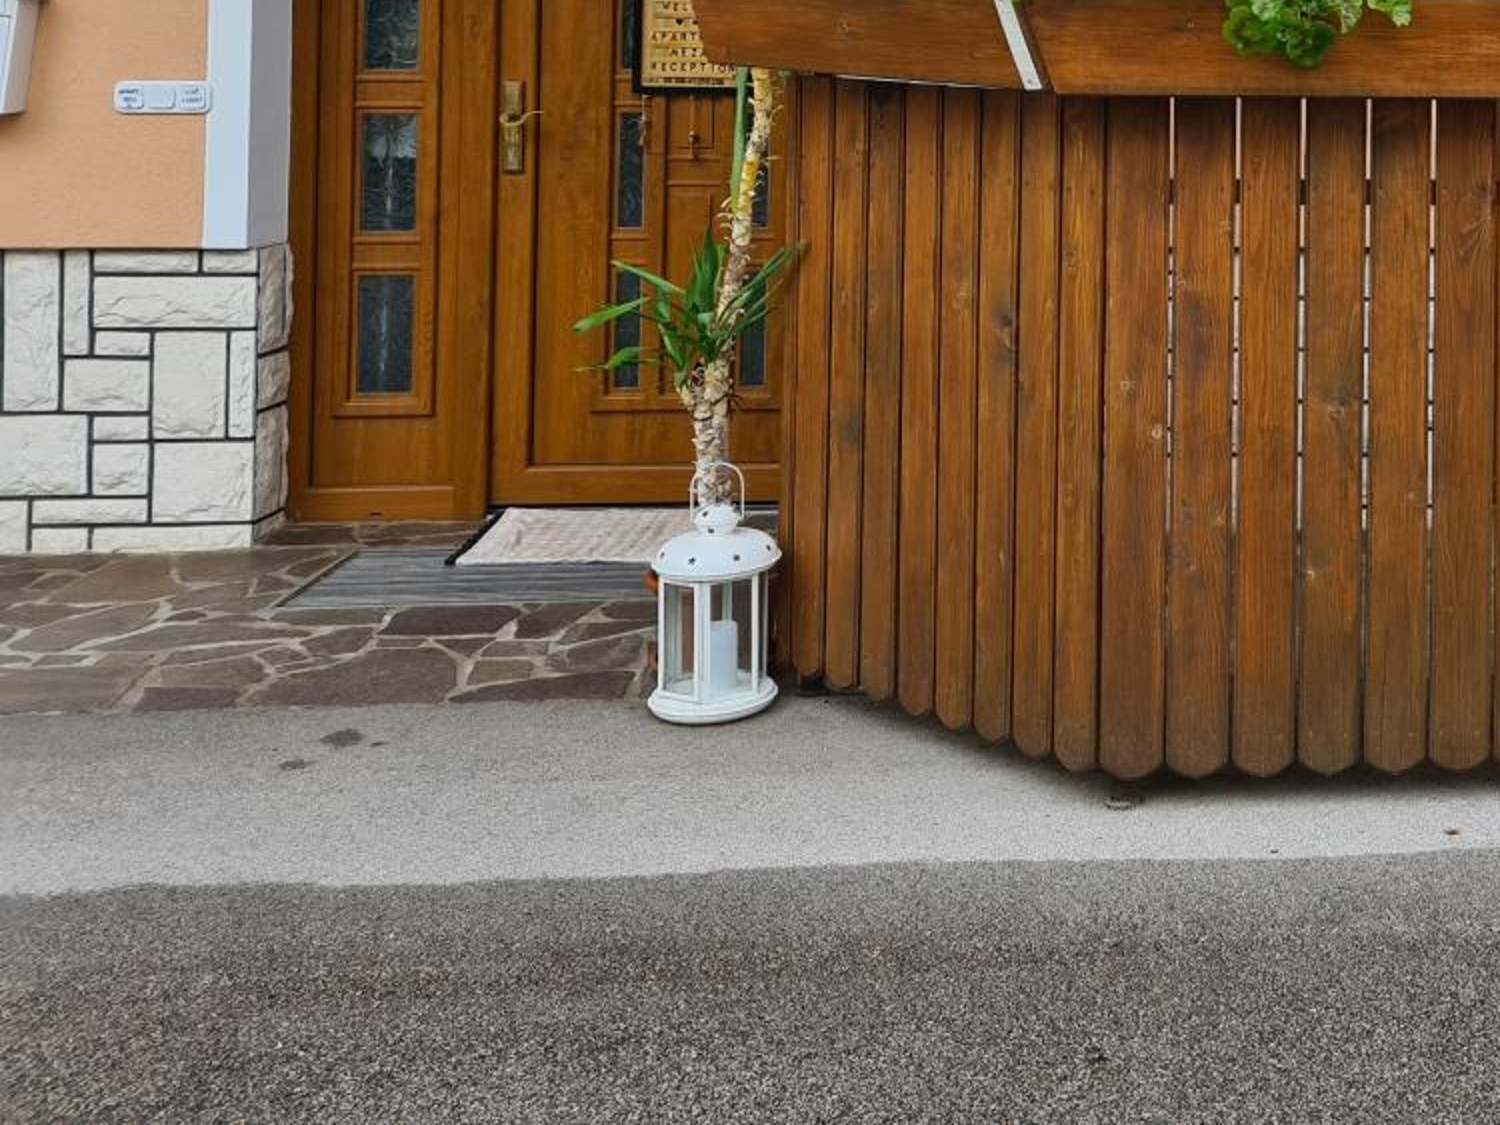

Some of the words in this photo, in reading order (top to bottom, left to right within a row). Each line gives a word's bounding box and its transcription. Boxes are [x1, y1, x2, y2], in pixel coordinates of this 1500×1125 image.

[662, 0, 689, 12] WEL
[651, 31, 700, 41] APART
[651, 61, 736, 73] RECEPTION
